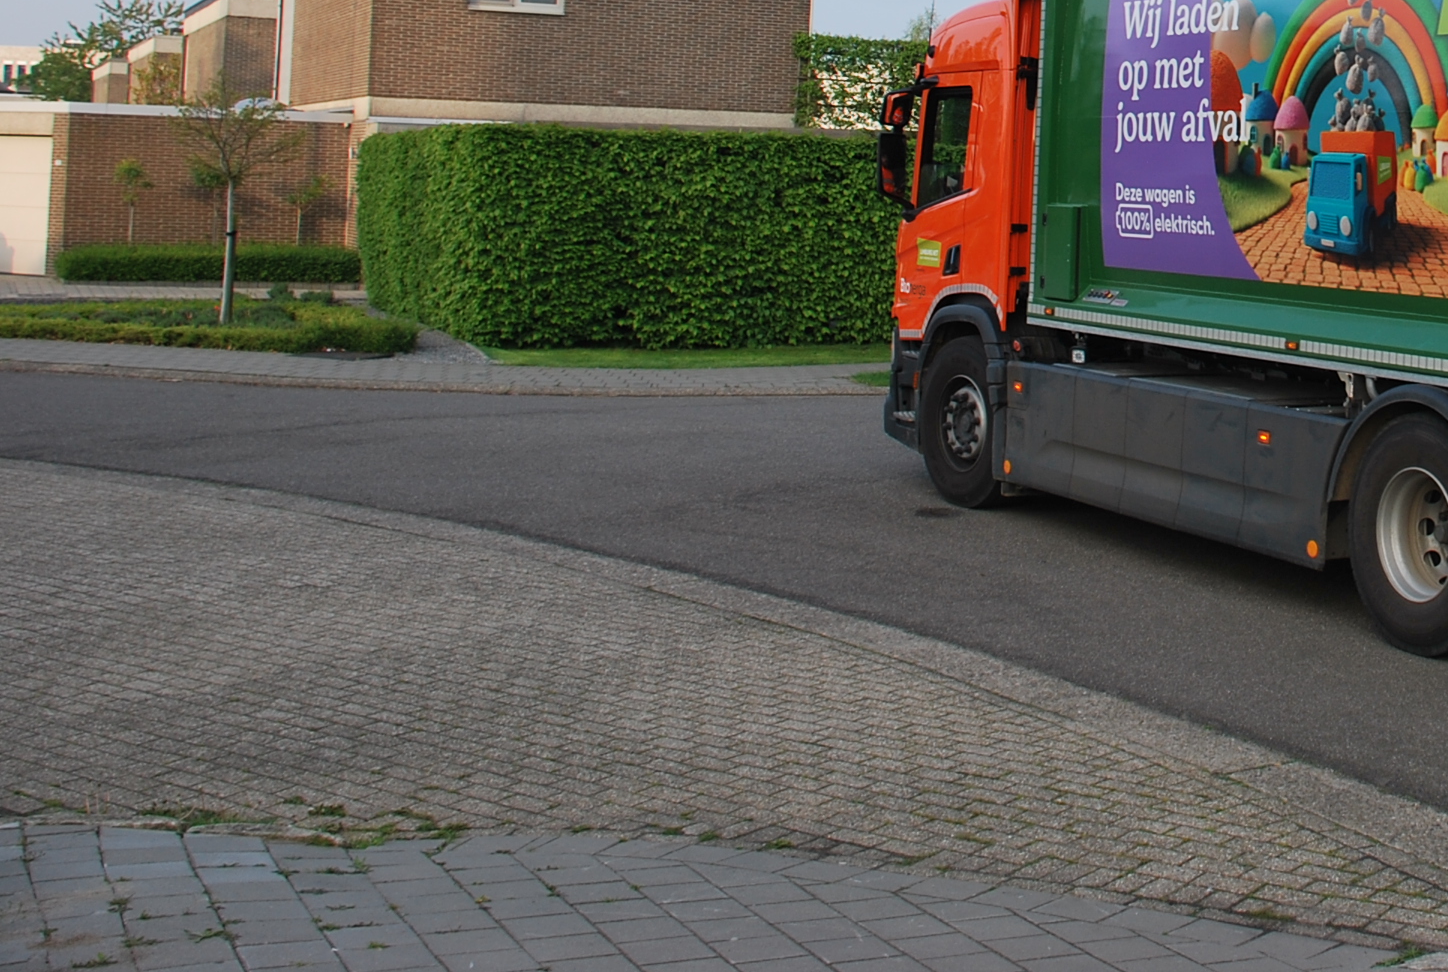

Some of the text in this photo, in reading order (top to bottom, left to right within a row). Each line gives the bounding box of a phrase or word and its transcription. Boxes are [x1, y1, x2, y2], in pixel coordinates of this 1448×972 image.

[1118, 50, 1205, 101] op met
[1114, 97, 1249, 153] jouw afval
[1115, 182, 1196, 208] Deze wagen is
[1120, 210, 1215, 236] 100% elektrisch.
